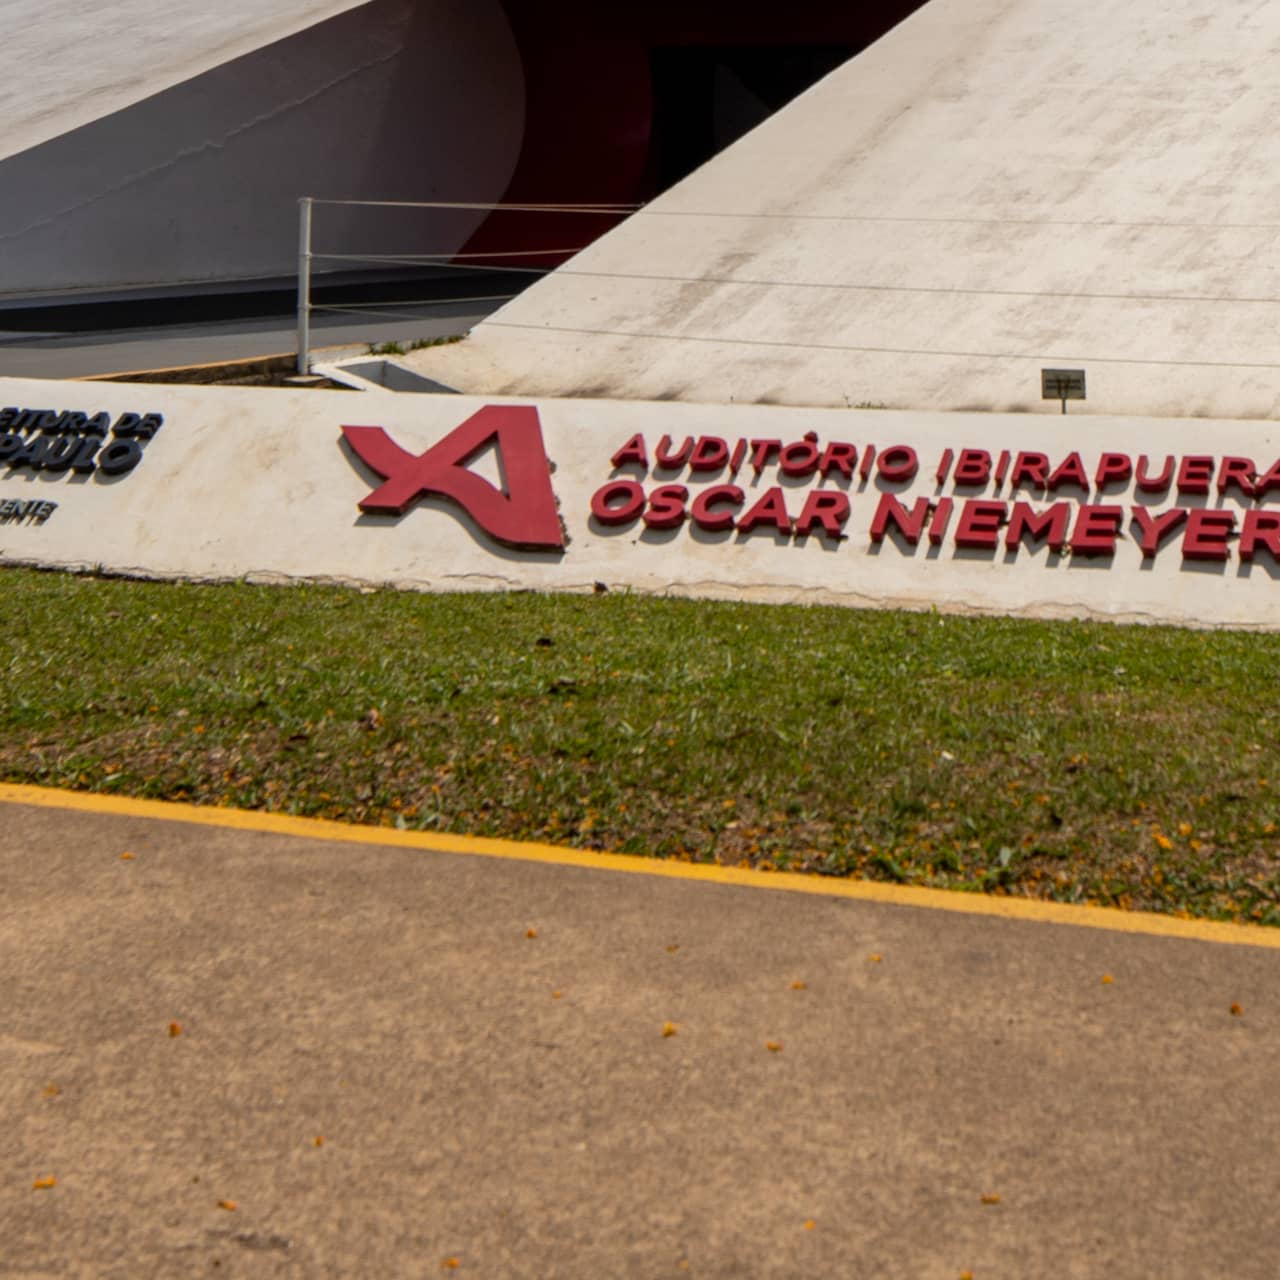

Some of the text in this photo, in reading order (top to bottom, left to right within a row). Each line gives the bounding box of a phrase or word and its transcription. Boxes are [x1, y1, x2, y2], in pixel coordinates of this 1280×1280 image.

[111, 412, 163, 440] DE
[610, 431, 918, 483] AUDITÓRIO
[590, 479, 850, 537] OSCAR
